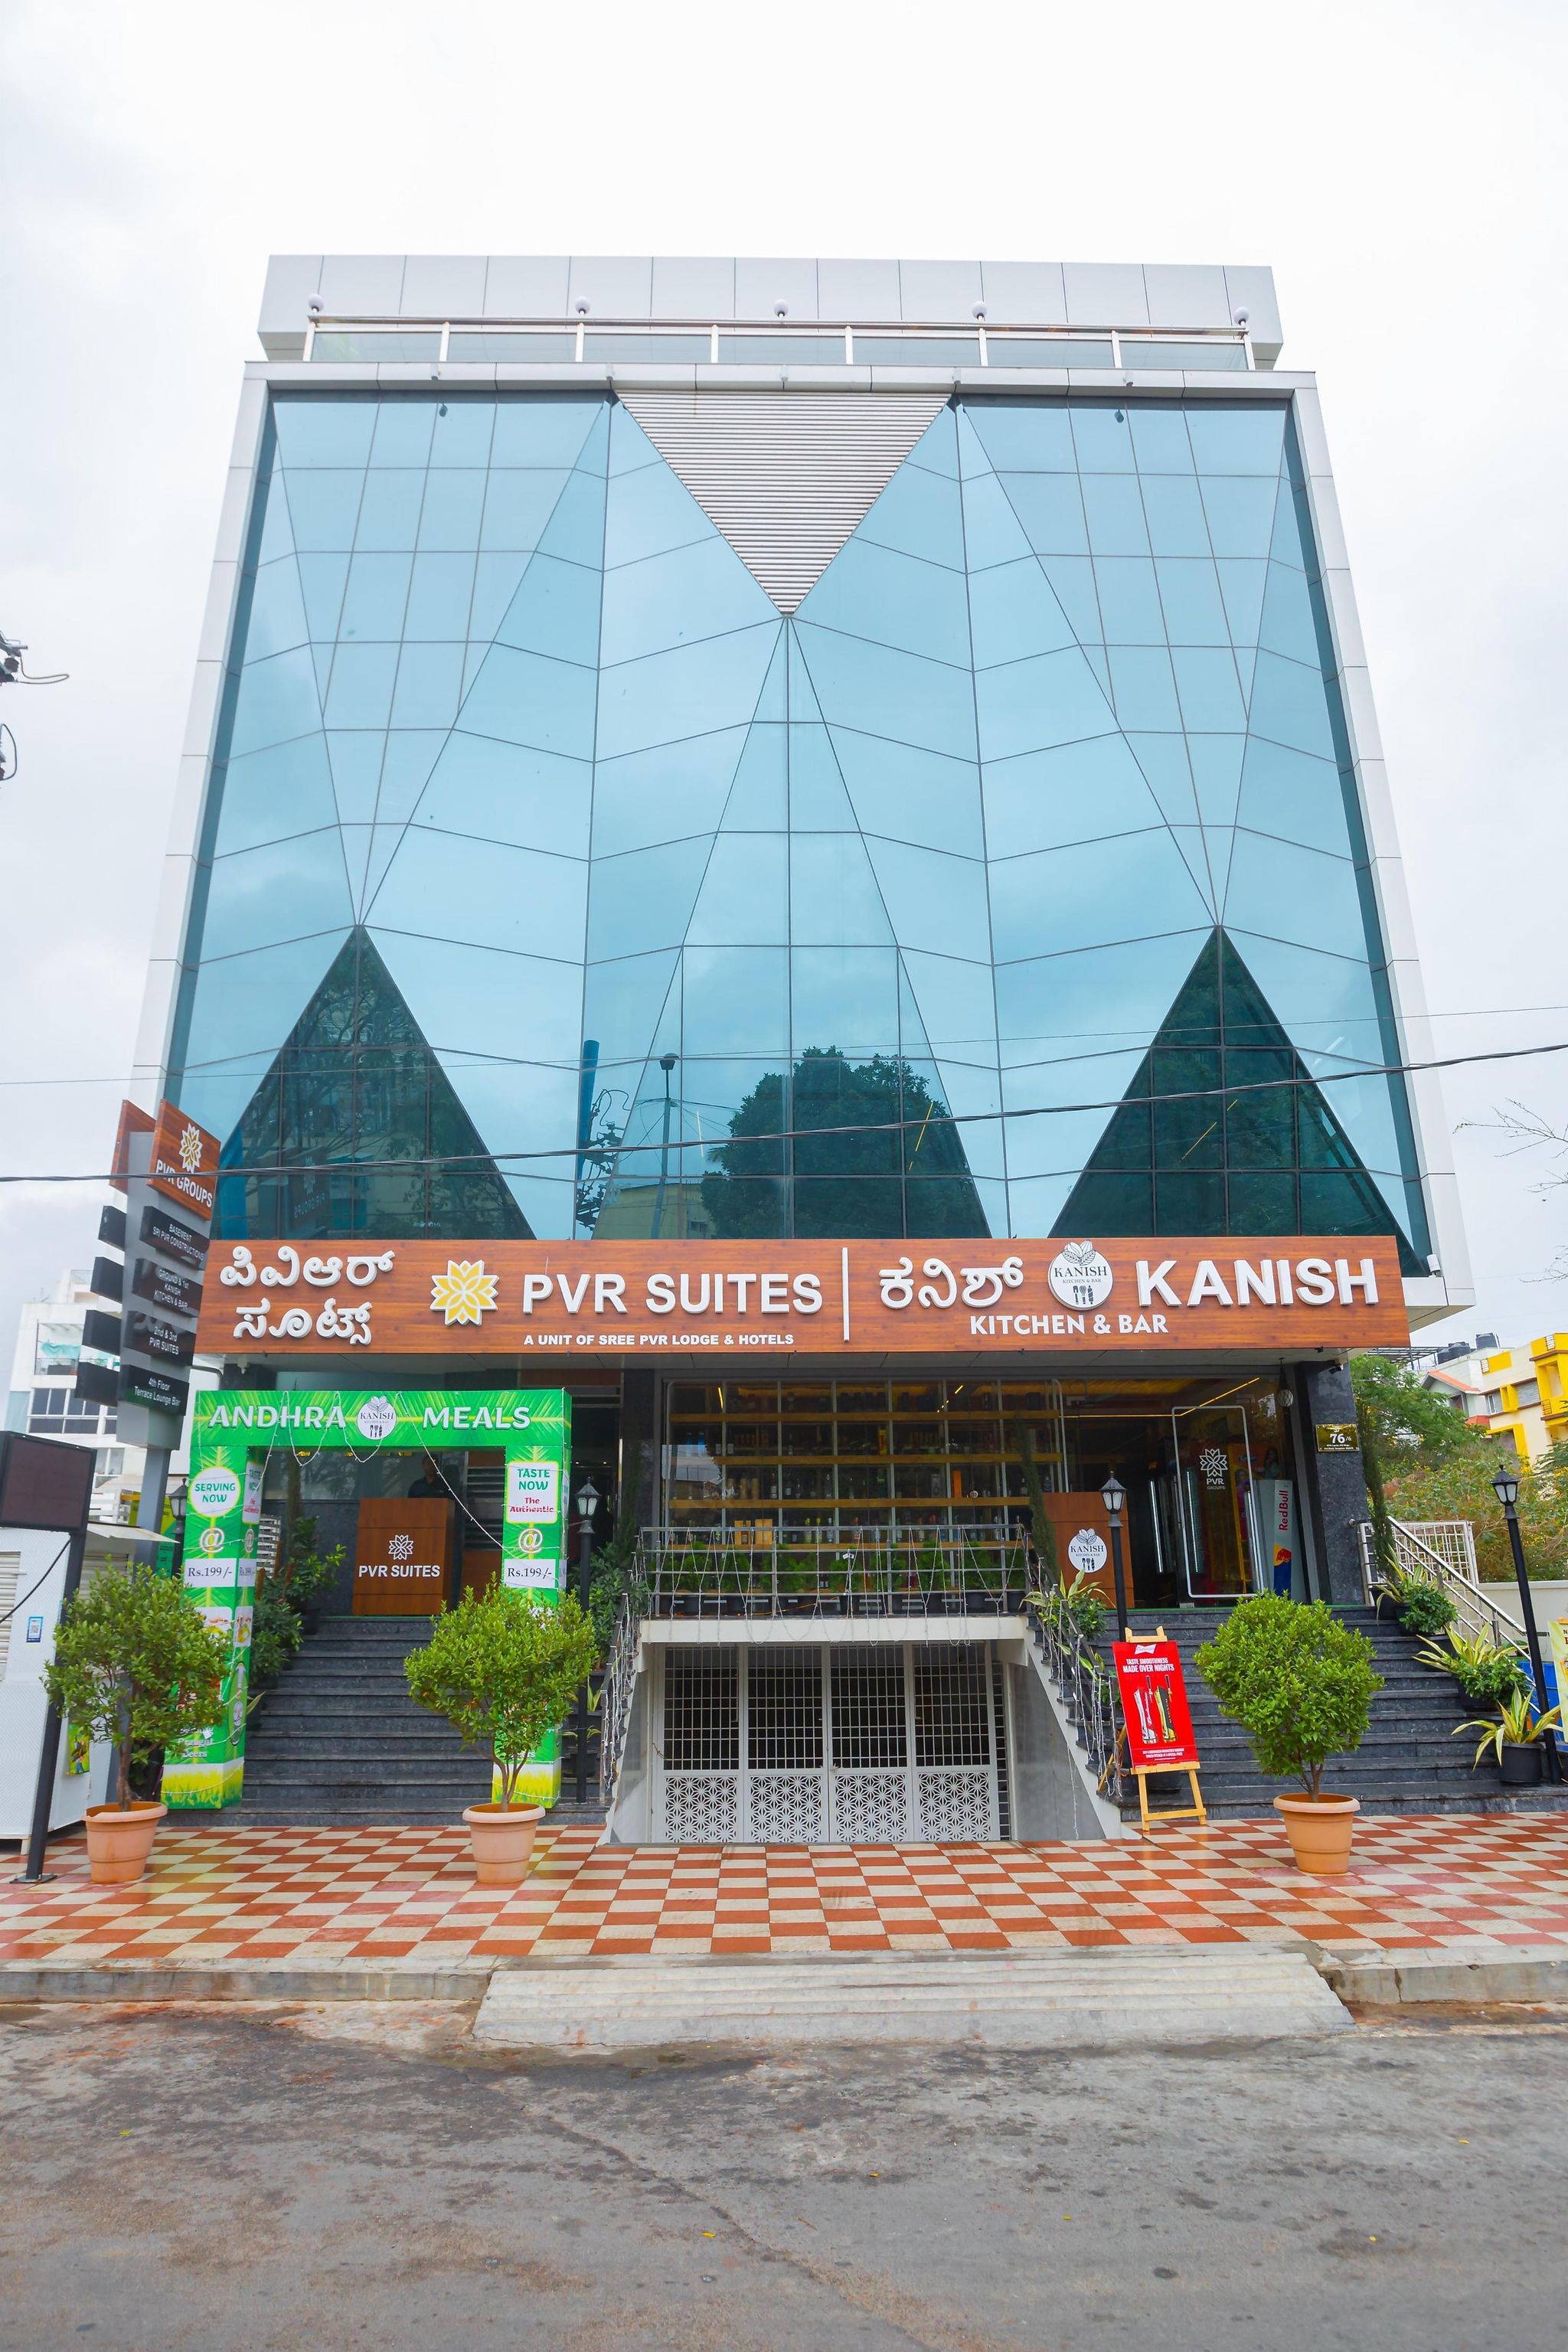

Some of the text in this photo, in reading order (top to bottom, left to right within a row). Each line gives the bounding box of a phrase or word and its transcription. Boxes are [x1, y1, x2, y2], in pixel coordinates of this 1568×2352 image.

[155, 1159, 212, 1207] PVR GROUPS
[169, 1224, 192, 1242] BASEMENT
[161, 1231, 170, 1242] PVR
[170, 1236, 204, 1260] CONSTRUCTIONS
[158, 1269, 178, 1283] GROUND
[1054, 1266, 1108, 1278] KANISH
[164, 1283, 181, 1295] KANISH
[1136, 1258, 1378, 1306] KANISH
[154, 1289, 174, 1304] KITCHEN
[178, 1299, 188, 1310] BAR
[523, 1273, 823, 1315] PVR SUITES
[970, 1314, 1169, 1335] KITCHEN & BAR
[154, 1326, 178, 1342] 2nd & 3rd
[524, 1334, 794, 1345] A UNIT OF SREE PVR LODGE & HOTELS
[149, 1337, 179, 1355] PVR SUITES
[148, 1377, 171, 1391] 4th Floor
[134, 1386, 181, 1406] Terrace Lounge Bar
[208, 1405, 531, 1430] ANDHRA MEALS
[517, 1468, 550, 1478] TASTE
[194, 1483, 236, 1491] SERVING
[518, 1481, 549, 1491] NOW
[202, 1494, 227, 1503] NOW
[200, 1527, 225, 1553] @
[518, 1527, 543, 1553] @
[358, 1565, 440, 1577] PVR SUITES
[1154, 1663, 1174, 1671] NIGHTS
